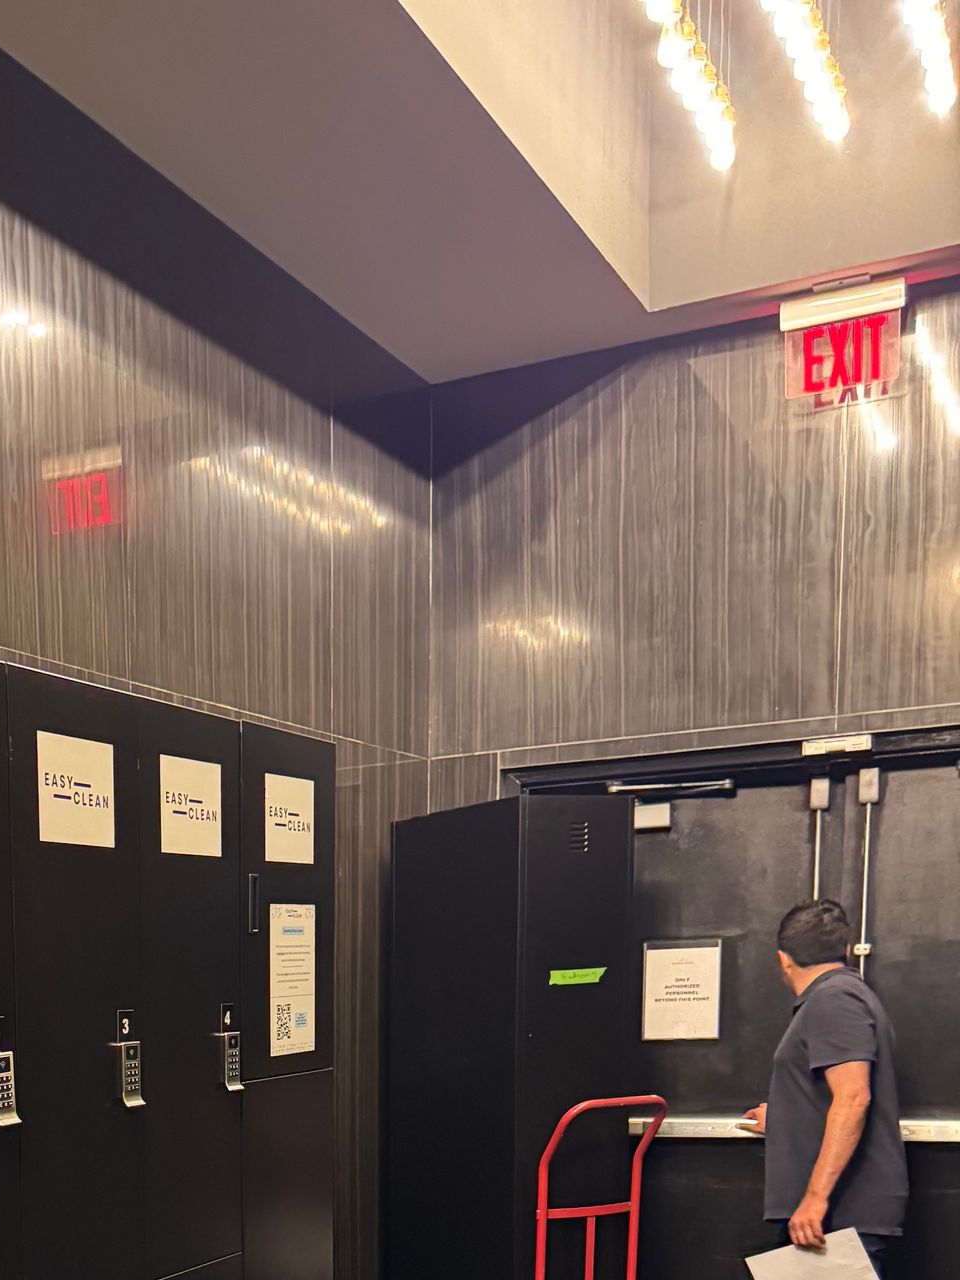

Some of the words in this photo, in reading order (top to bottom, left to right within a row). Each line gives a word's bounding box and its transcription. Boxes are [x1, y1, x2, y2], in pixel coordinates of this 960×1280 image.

[803, 313, 888, 393] EXIT
[44, 772, 73, 789] EASY
[73, 791, 109, 809] CLEAN
[165, 791, 188, 806] EASY
[188, 807, 217, 822] CLEAN
[269, 805, 288, 818] EASY
[287, 820, 311, 832] CLEAN
[122, 1018, 129, 1034] 3
[224, 1010, 231, 1026] 4
